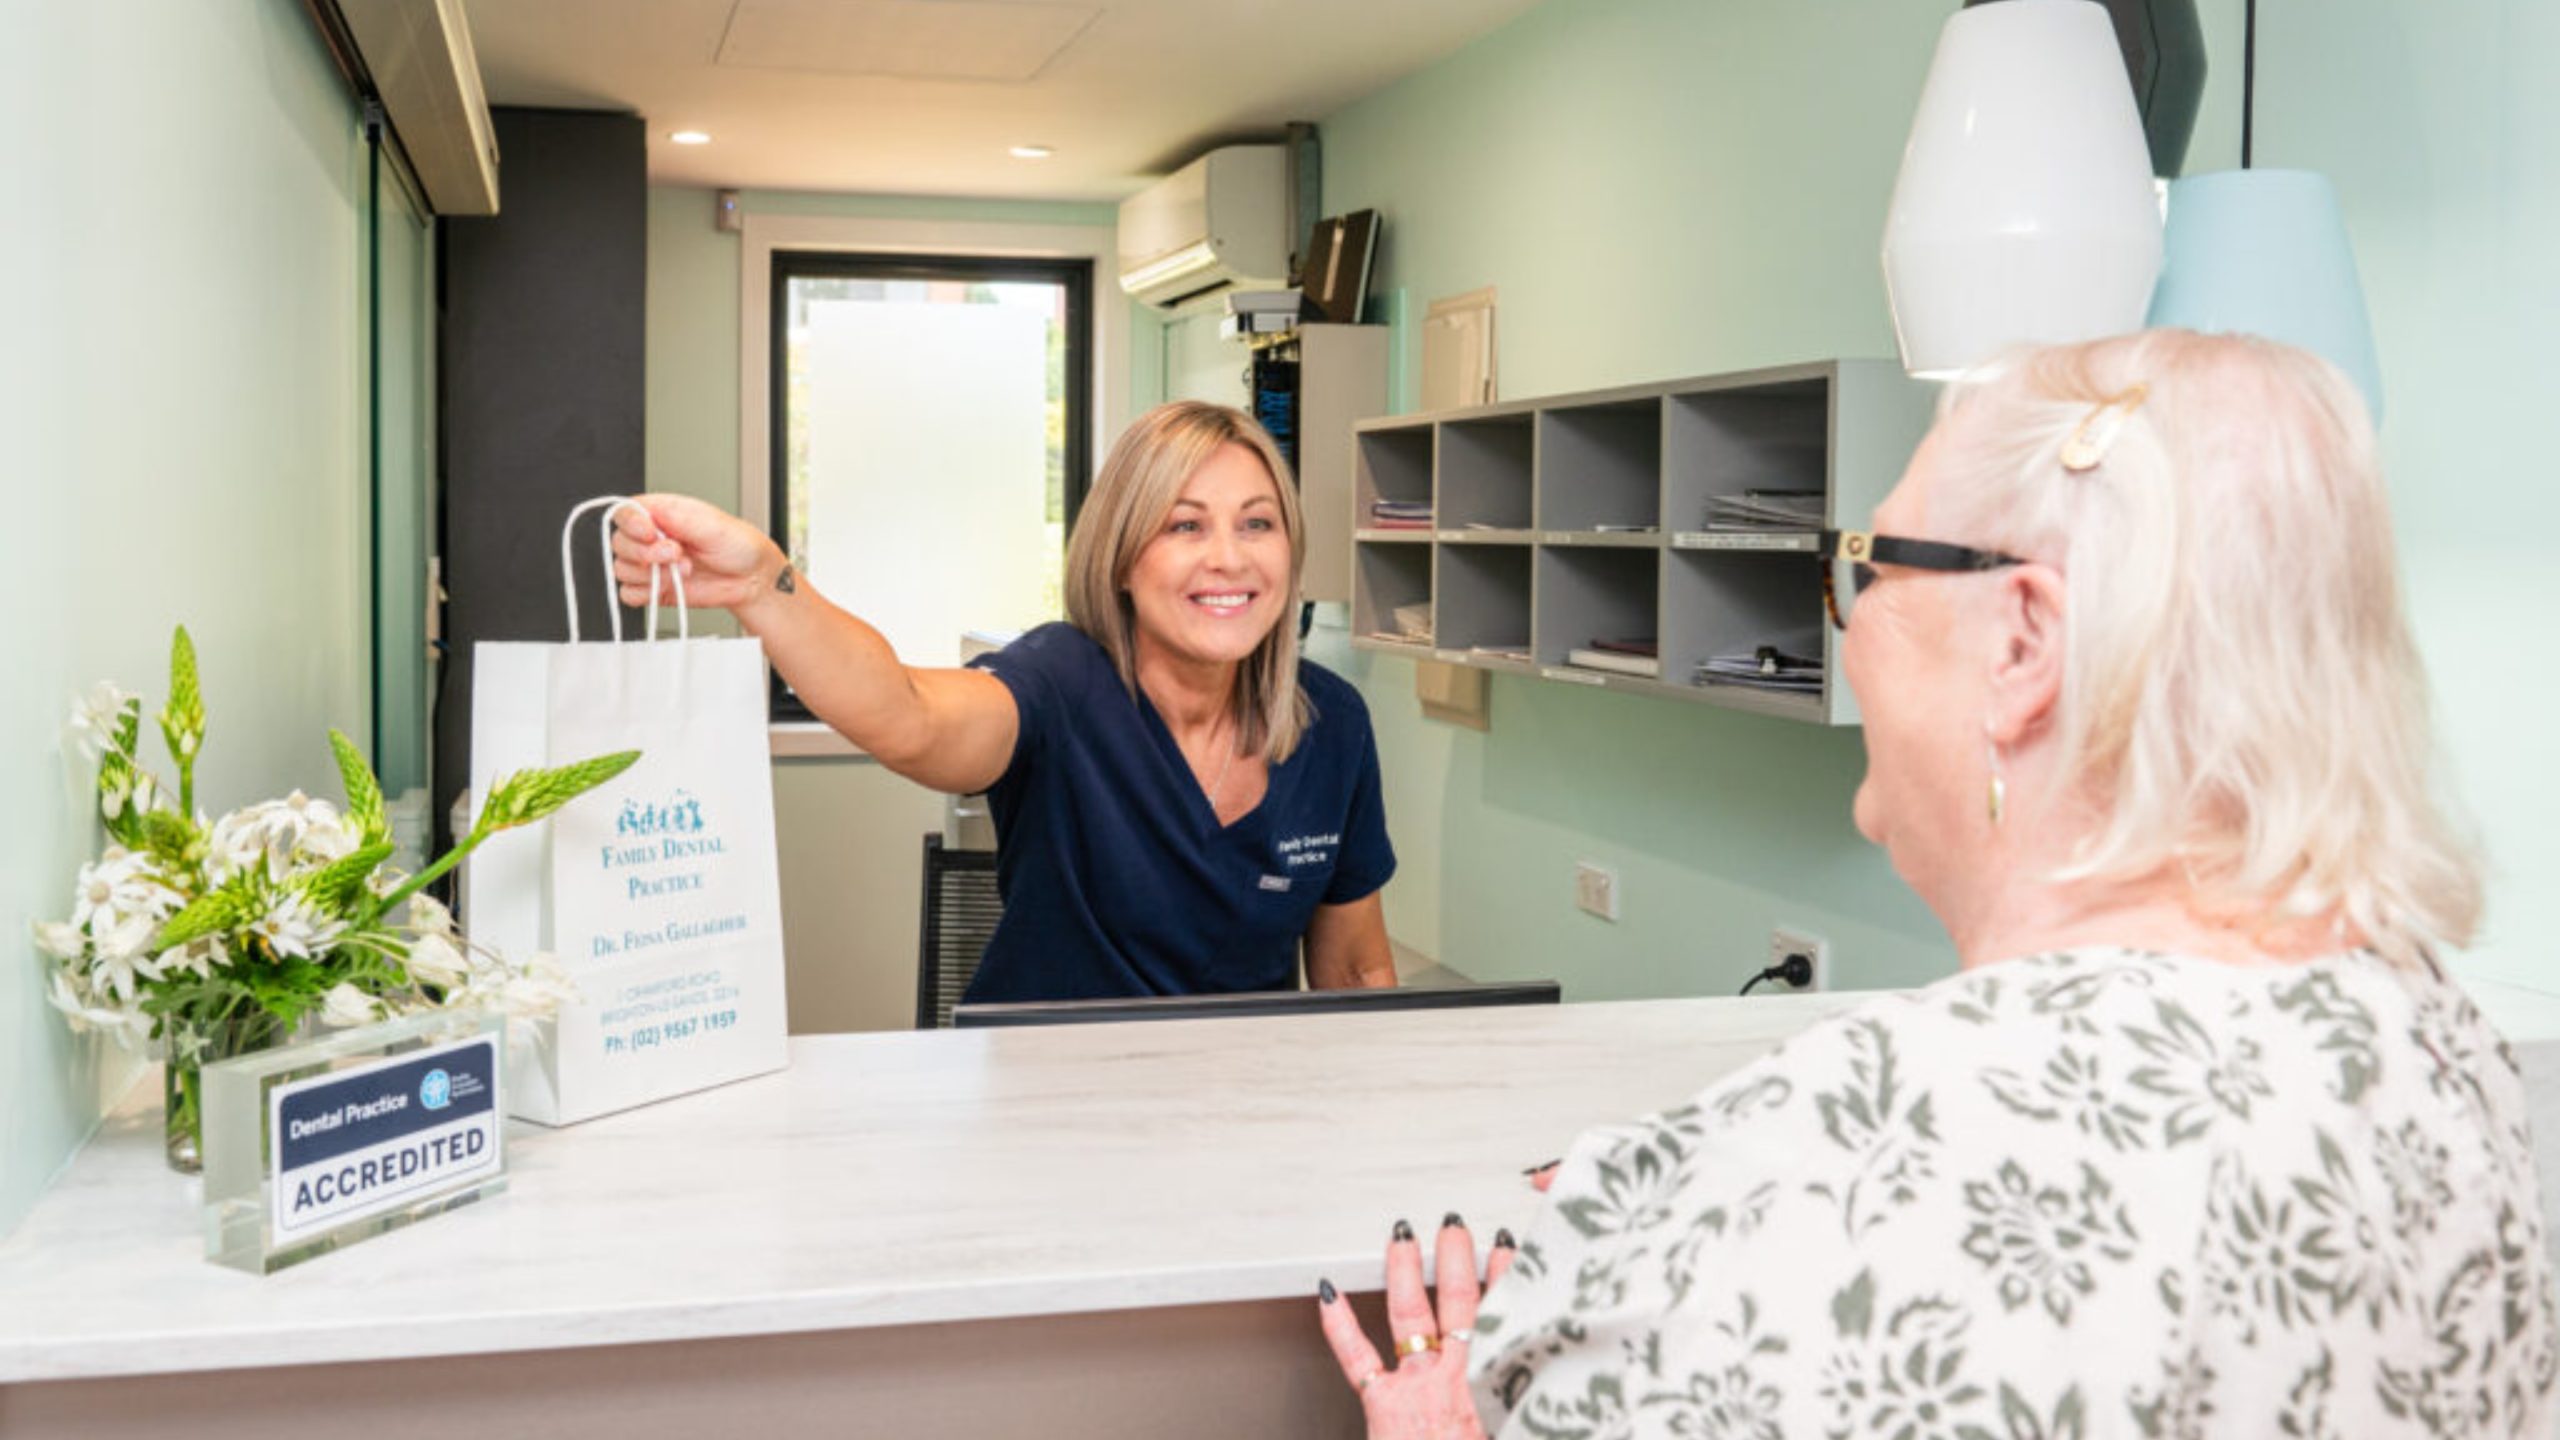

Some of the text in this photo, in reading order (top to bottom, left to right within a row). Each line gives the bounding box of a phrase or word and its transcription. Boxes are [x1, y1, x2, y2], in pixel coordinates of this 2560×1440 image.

[601, 837, 727, 869] FAMILY DENTAL
[628, 873, 703, 900] PRACTICE
[631, 1025, 661, 1051] (02)
[664, 1015, 698, 1039] 9567
[289, 1092, 409, 1140] Dental Practice
[293, 1127, 485, 1213] ACCREDITED
